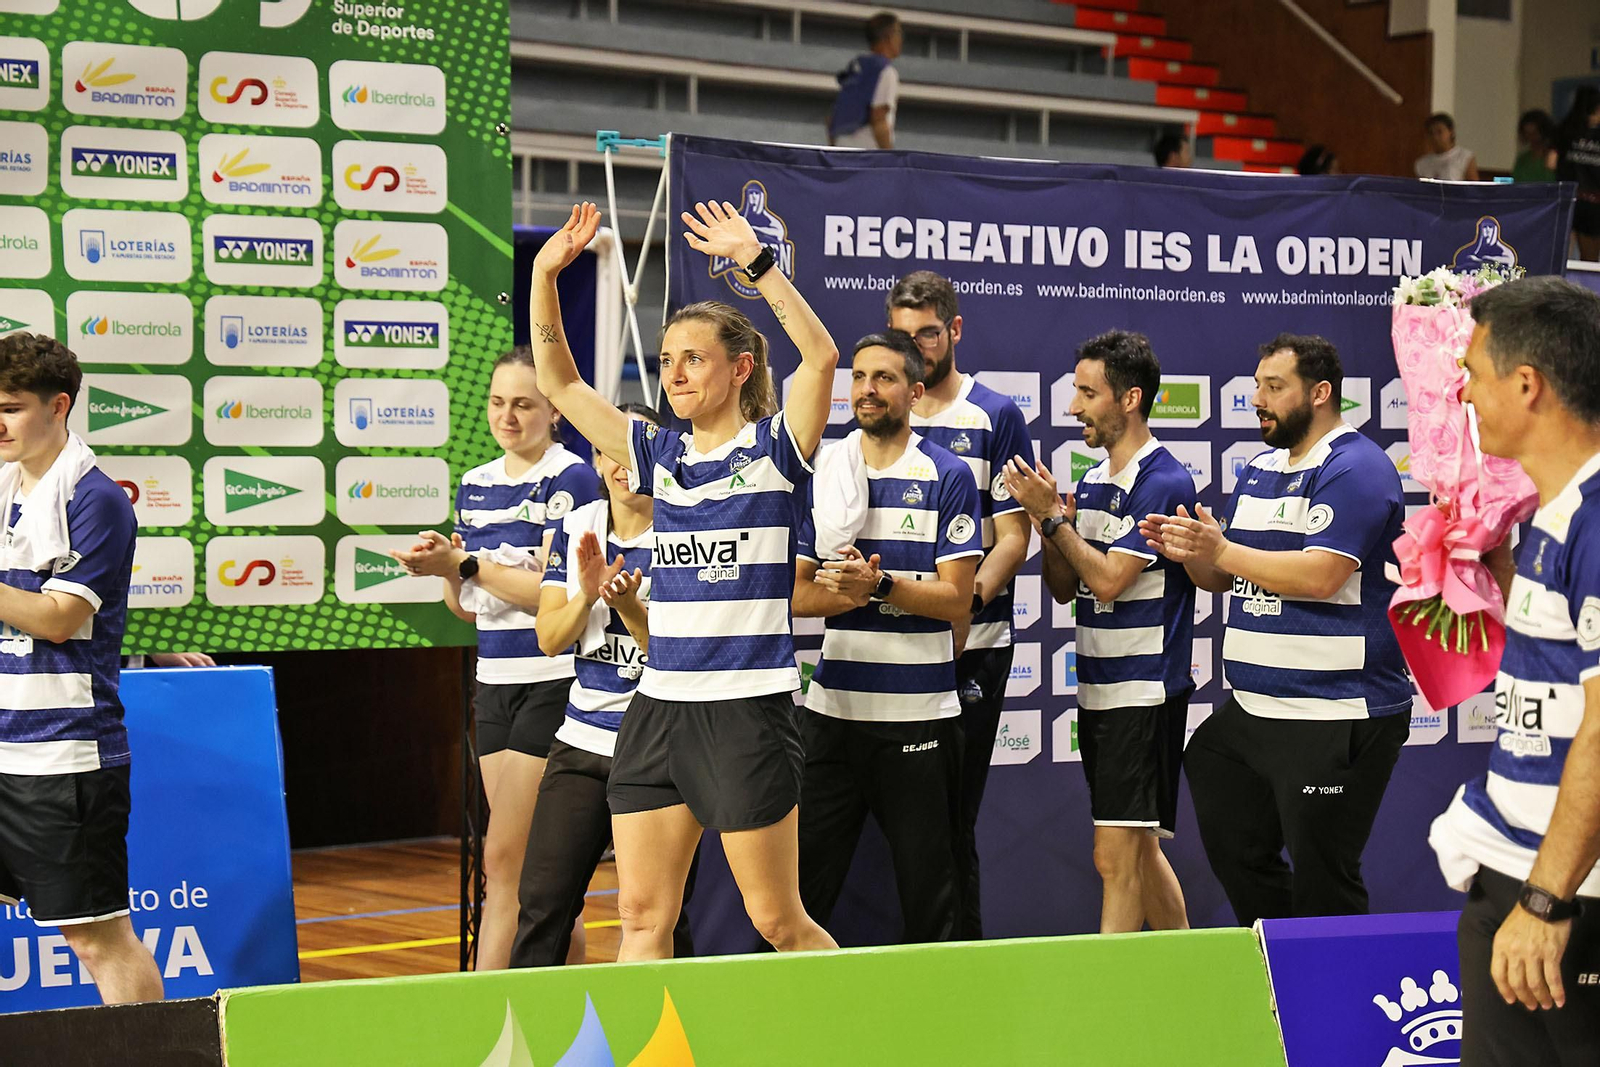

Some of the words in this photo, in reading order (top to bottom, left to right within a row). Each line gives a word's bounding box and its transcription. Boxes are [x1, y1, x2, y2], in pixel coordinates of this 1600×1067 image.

[333, 0, 405, 18] Superior
[331, 19, 350, 35] de
[356, 21, 436, 40] Deportes
[91, 91, 175, 107] BADMINTON
[371, 91, 436, 107] Iberdrola
[113, 154, 171, 176] YONEX
[229, 181, 311, 195] BADMINTON
[110, 239, 175, 252] LOTERÍAS
[253, 241, 308, 262] YONEX
[824, 214, 1109, 266] RECREATIVO
[1124, 230, 1193, 274] IES
[1207, 234, 1263, 275] LA
[1275, 236, 1423, 277] ORDEN
[361, 266, 438, 279] BADMINTON
[824, 273, 1024, 297] www.badaorden.es
[1036, 283, 1226, 304] www.badmintonlaorden.es
[112, 320, 182, 336] Iberdrola
[248, 324, 308, 337] LOTERÍAS
[381, 325, 434, 345] YONEX
[246, 405, 312, 419] Iberdrola
[377, 404, 435, 418] LOTERÍAS
[1155, 405, 1197, 414] IBERDROLA
[376, 484, 439, 498] Iberdrola
[699, 567, 738, 582] original
[1243, 600, 1280, 614] original
[1319, 785, 1344, 794] YONEX
[170, 881, 208, 909] de
